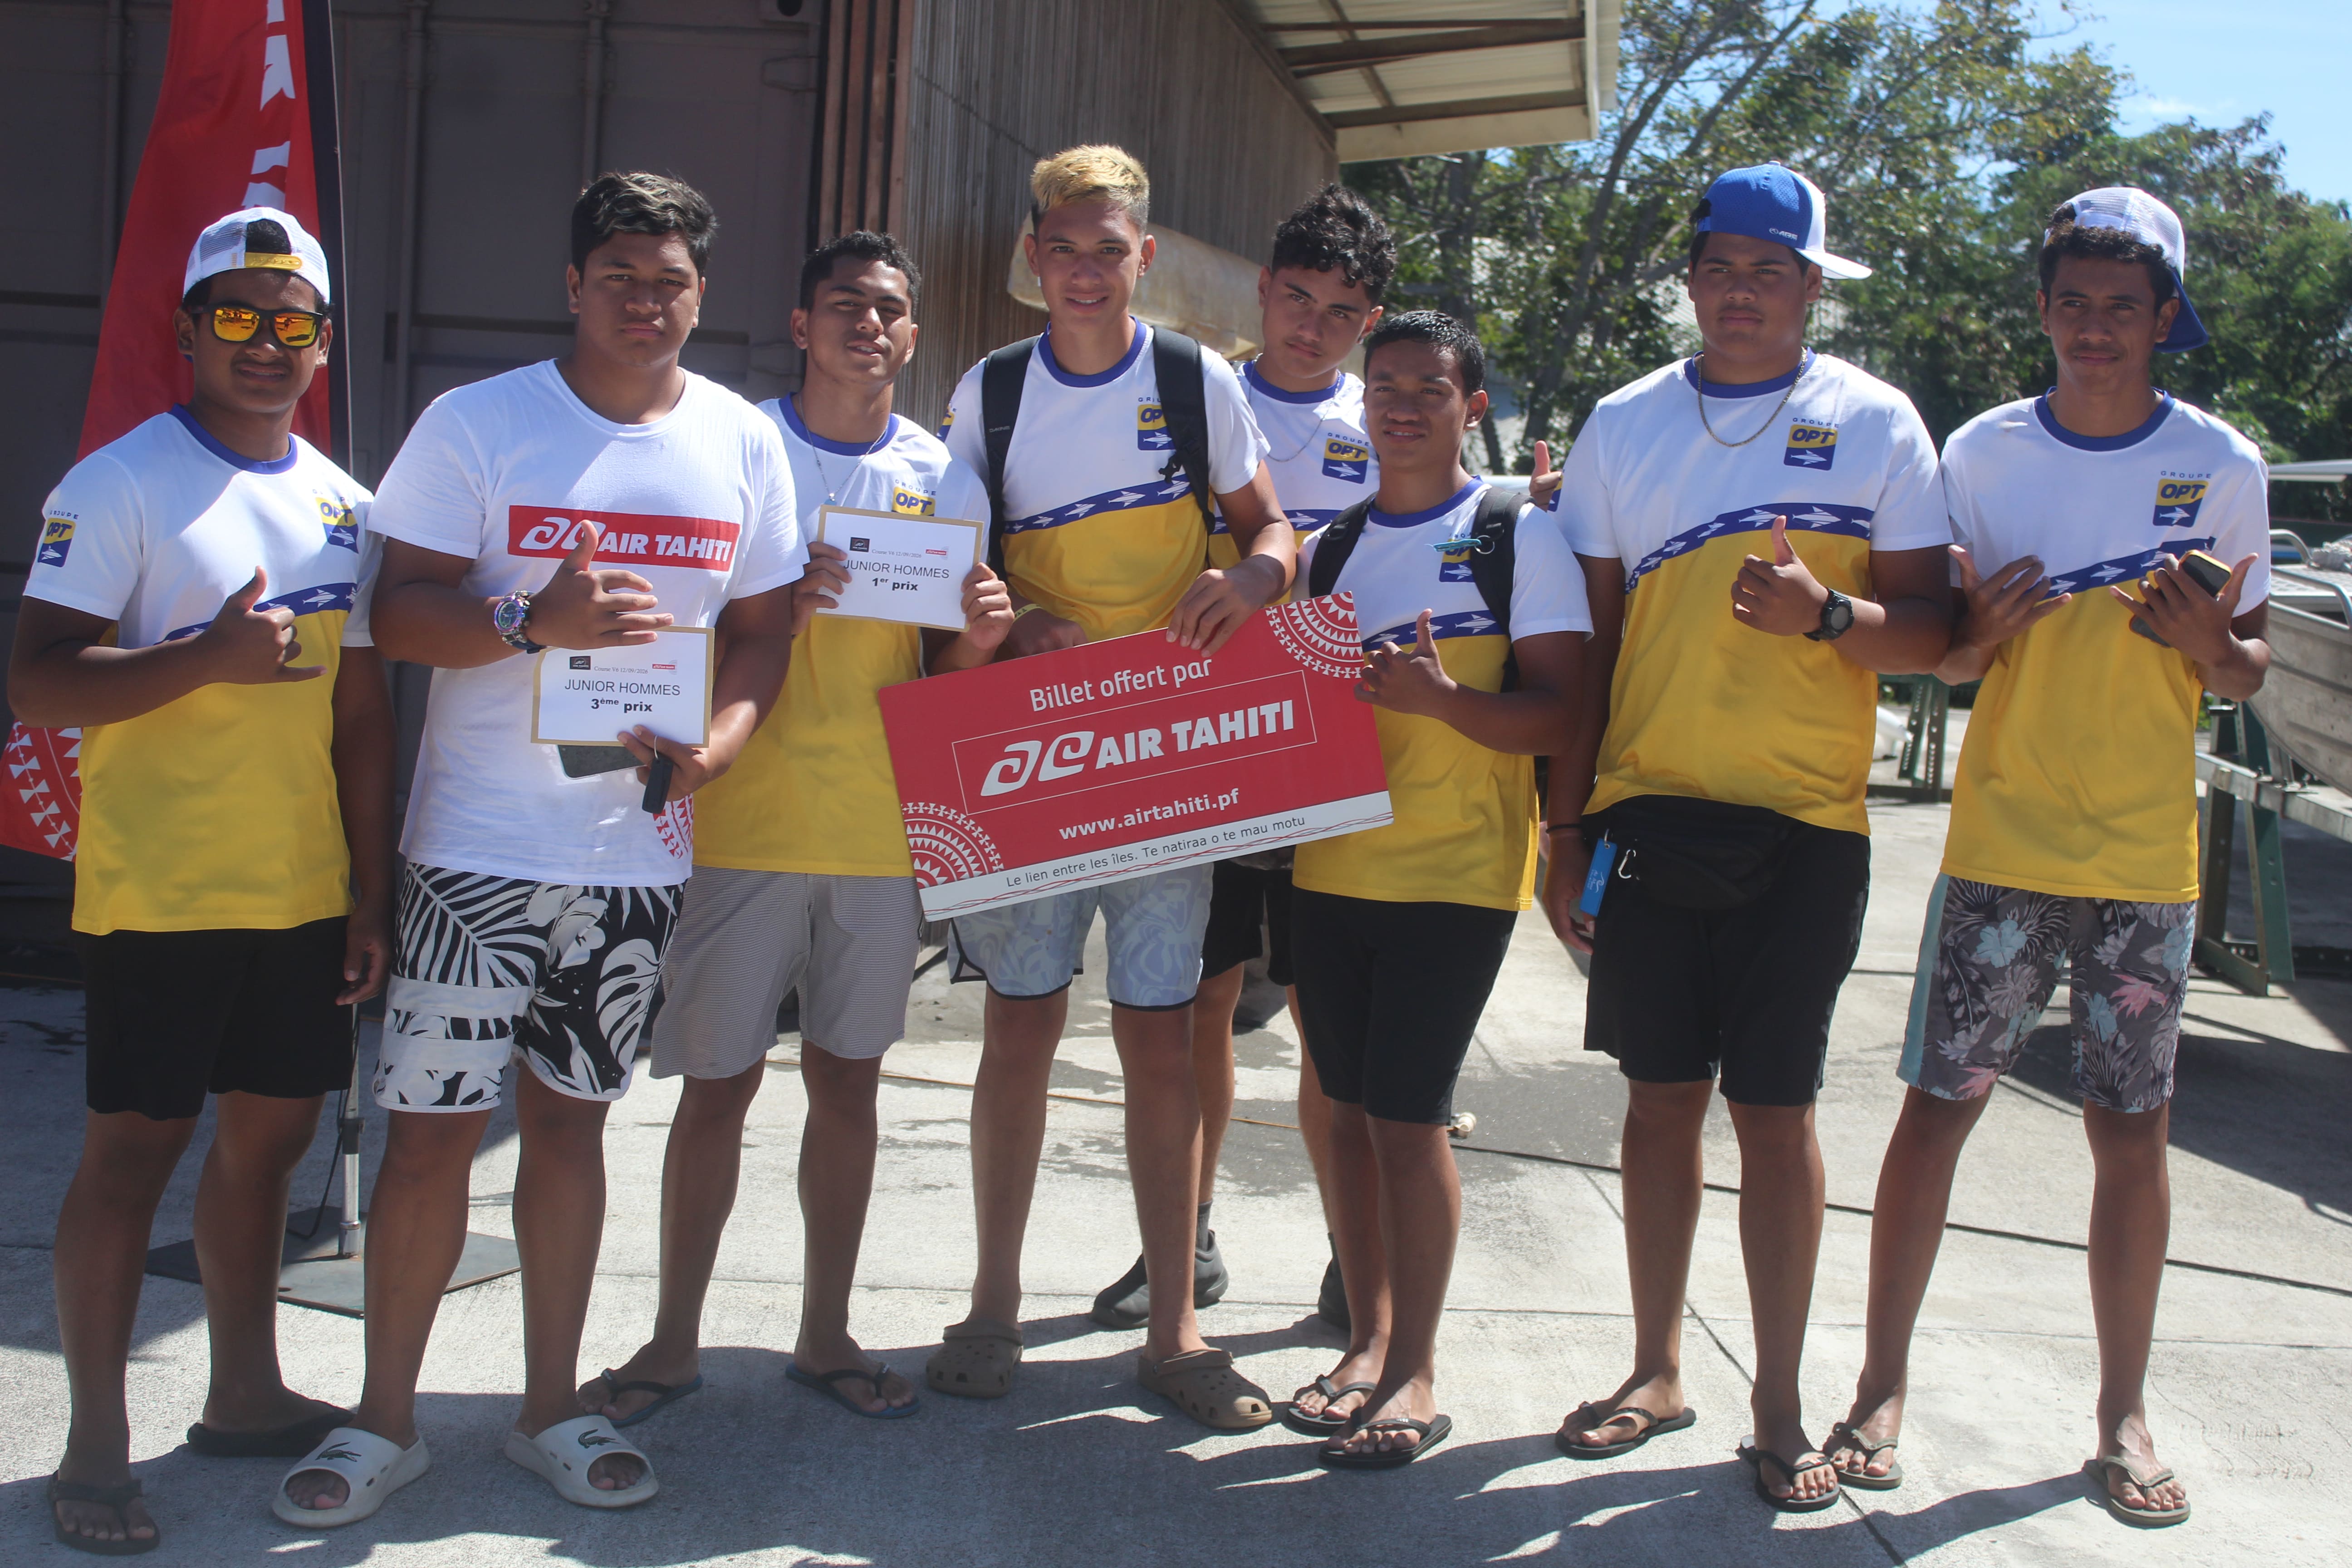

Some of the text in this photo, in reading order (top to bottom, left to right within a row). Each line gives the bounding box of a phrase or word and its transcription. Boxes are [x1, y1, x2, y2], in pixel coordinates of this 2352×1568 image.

[1140, 407, 1163, 423] OP
[1793, 417, 1840, 428] GROUPE
[1328, 432, 1369, 446] GROUPE
[1792, 428, 1835, 444] OPT
[1328, 442, 1366, 459] OPT
[2160, 470, 2212, 479] GROUPE
[895, 479, 936, 496] GROUPE
[2160, 483, 2206, 500] OPT
[895, 492, 932, 513] OPT
[596, 532, 732, 562] AIR TAHITI
[843, 559, 950, 579] JUNIOR HOMMES
[892, 579, 918, 591] prix
[564, 679, 681, 696] JUNIOR HOMMES
[1029, 659, 1212, 712] Billet offert par
[623, 701, 653, 713] prix
[1095, 700, 1294, 770] AIR TAHITI
[1058, 788, 1239, 840] www.airtahiti.pf
[1006, 817, 1305, 887] Le lien entre les îles. Te natiraa o te mau motu
